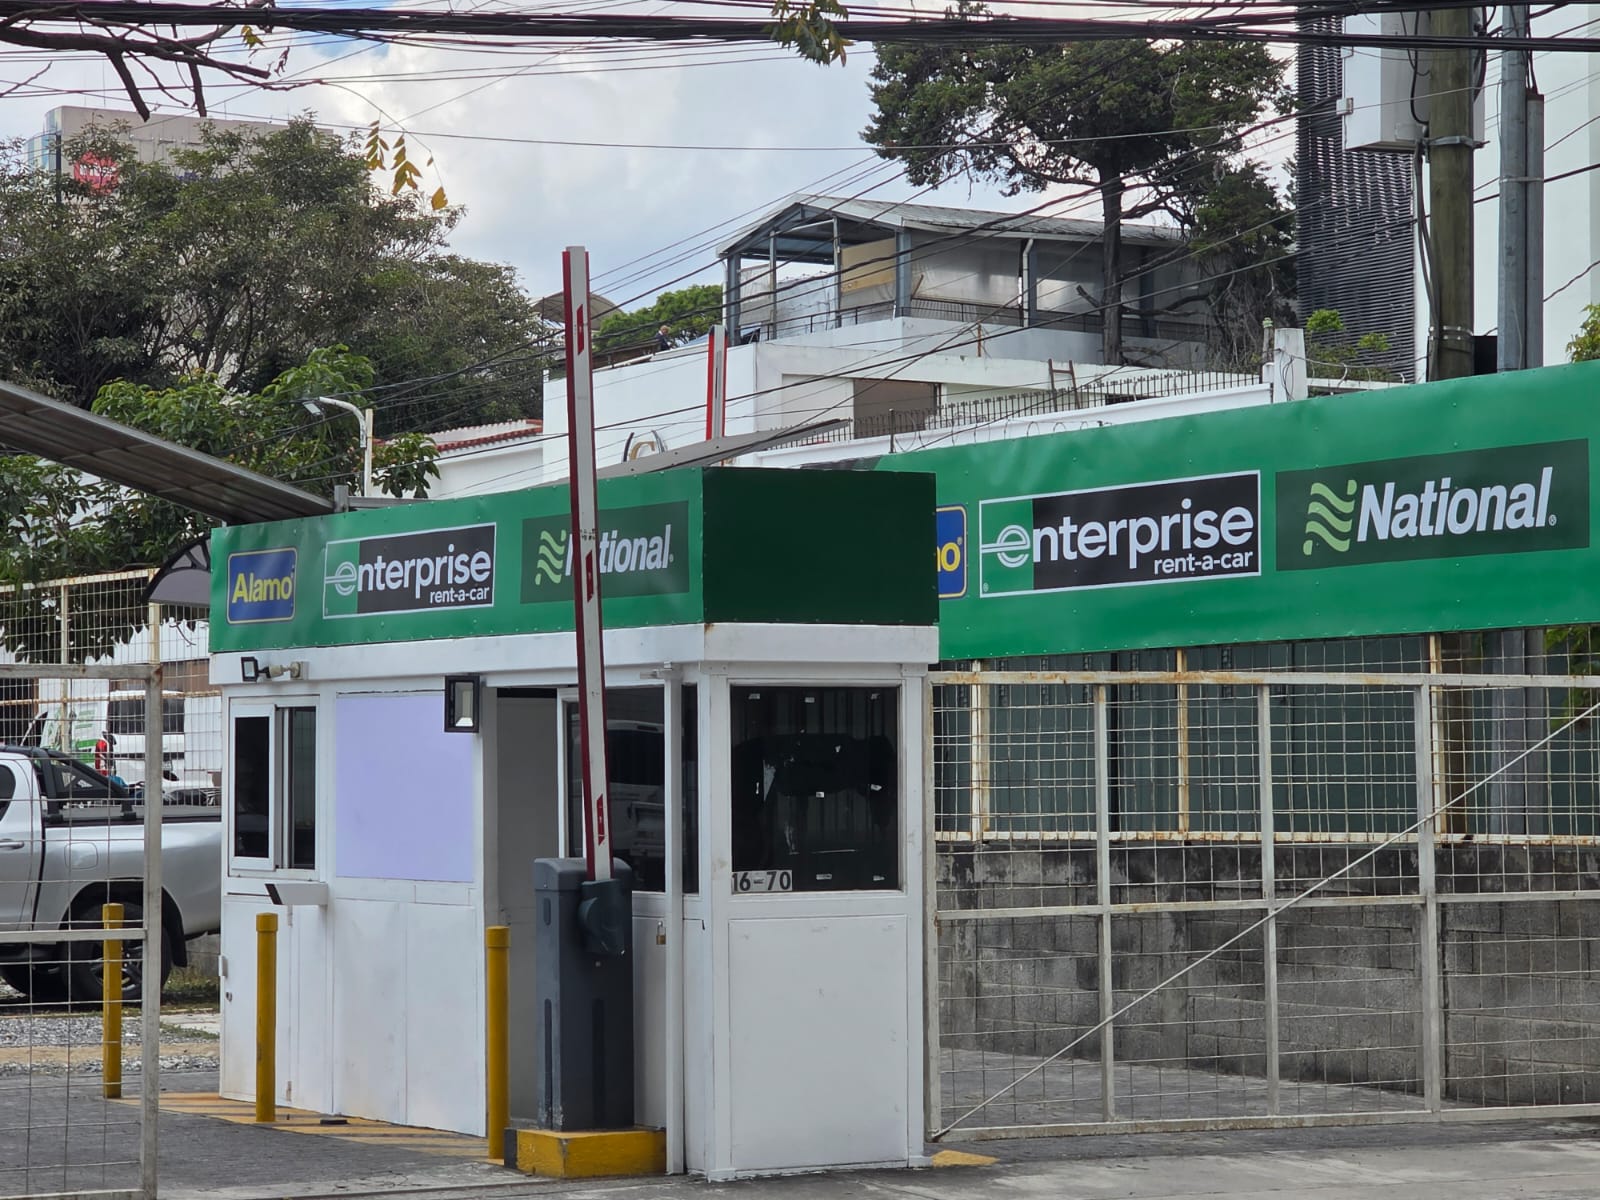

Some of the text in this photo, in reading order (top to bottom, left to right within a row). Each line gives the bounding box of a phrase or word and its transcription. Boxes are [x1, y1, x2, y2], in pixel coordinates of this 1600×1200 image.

[565, 524, 671, 576] tional
[994, 498, 1254, 569] enterprise
[334, 543, 491, 599] enterprise
[1154, 551, 1253, 575] rent-a-car
[429, 585, 490, 604] rent-a-car
[733, 871, 791, 891] 16-70
